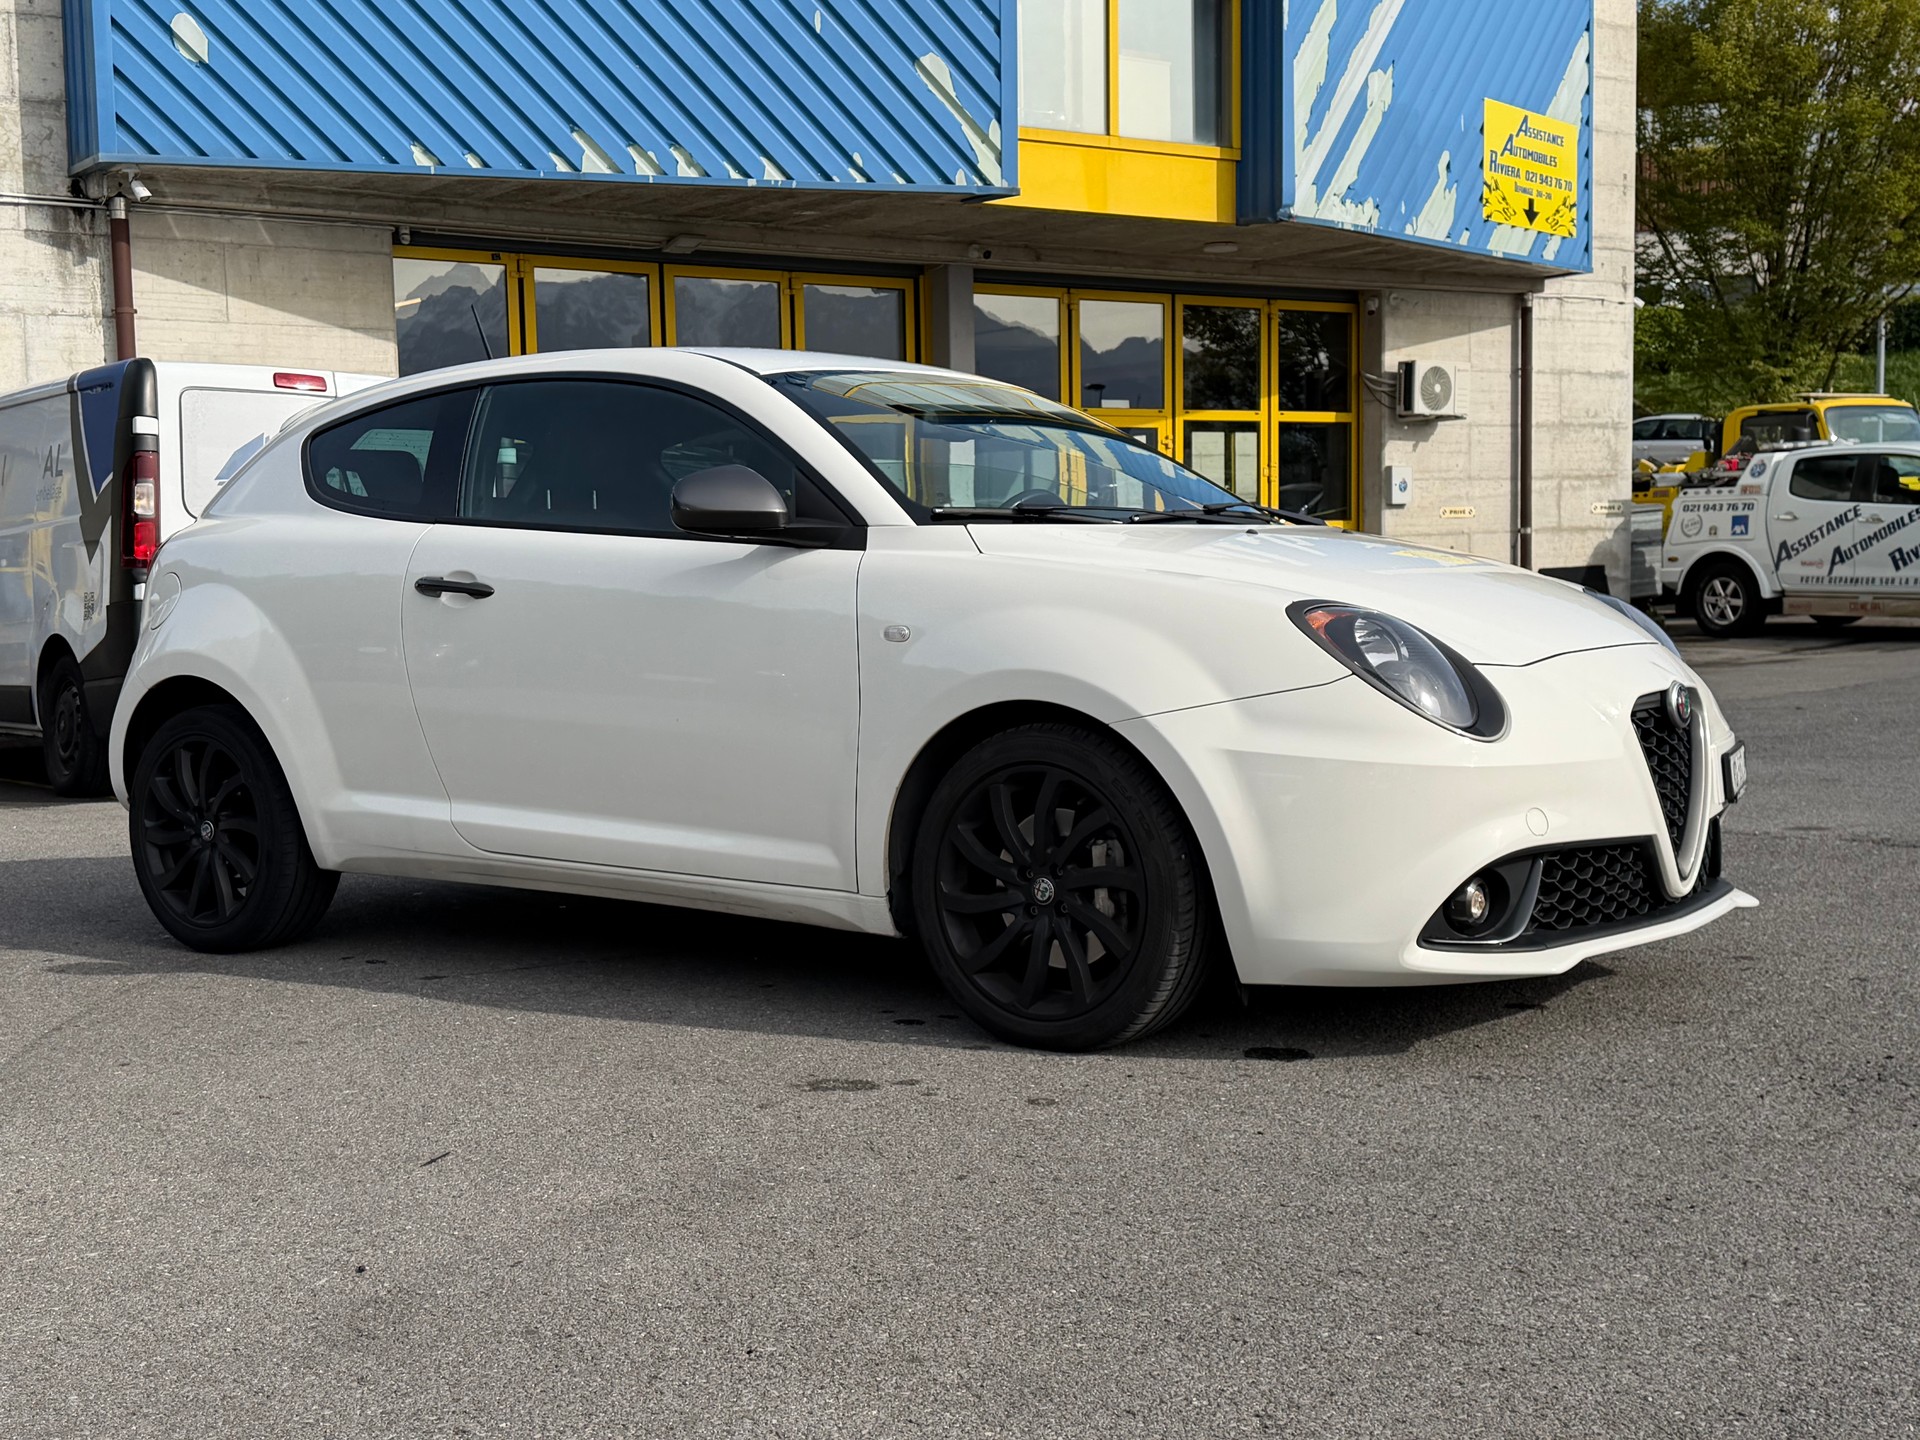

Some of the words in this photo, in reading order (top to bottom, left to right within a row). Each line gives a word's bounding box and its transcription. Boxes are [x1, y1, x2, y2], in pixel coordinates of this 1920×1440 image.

[1515, 114, 1564, 147] ASSISTANCE
[1500, 133, 1557, 167] AUTOMOBILES
[1489, 150, 1521, 179] RIVIERA
[1525, 169, 1538, 184] 021
[1539, 172, 1553, 188] 943
[1554, 178, 1563, 190] 76
[1564, 180, 1573, 192] 70
[1682, 503, 1700, 513] 021
[1702, 503, 1724, 512] 943
[1726, 502, 1739, 511] 76
[1741, 502, 1755, 511] 70
[1775, 504, 1862, 572] ASSISTANCE
